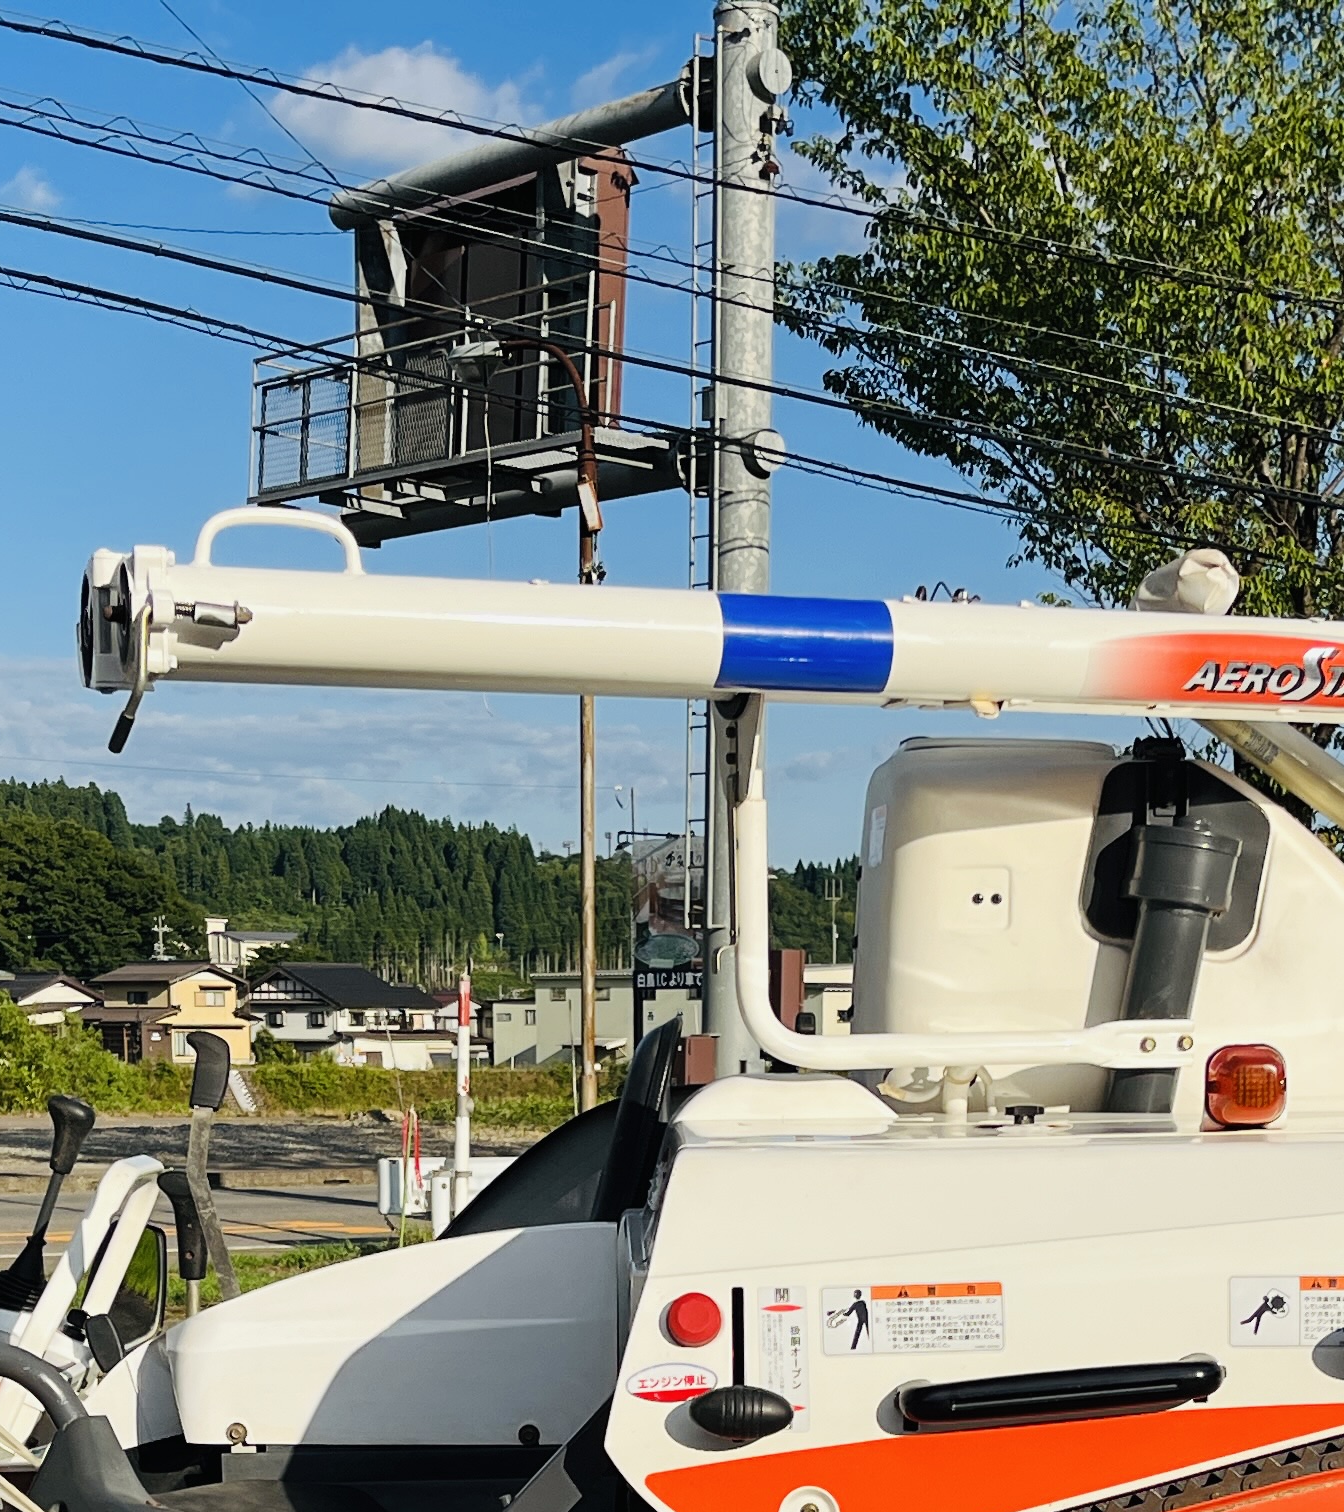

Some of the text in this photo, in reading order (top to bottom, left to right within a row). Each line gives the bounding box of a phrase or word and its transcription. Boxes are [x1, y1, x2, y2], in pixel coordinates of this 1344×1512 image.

[637, 1374, 708, 1390] エンジン停止
